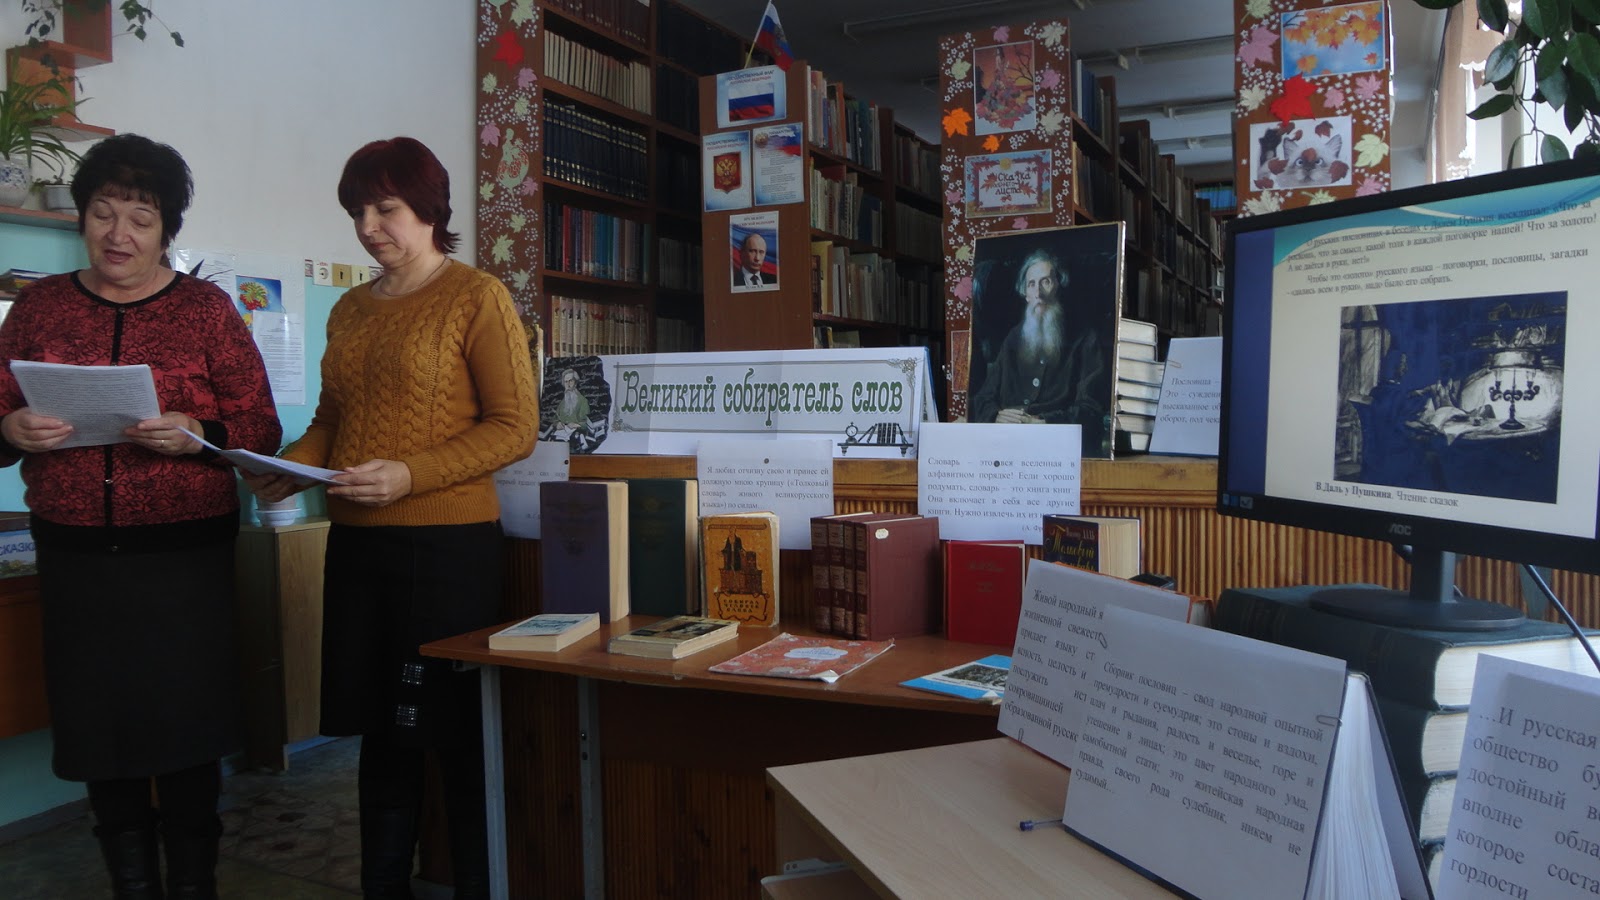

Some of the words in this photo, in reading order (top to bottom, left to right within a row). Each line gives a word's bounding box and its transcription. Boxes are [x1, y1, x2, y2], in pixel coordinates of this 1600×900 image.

[1445, 229, 1488, 242] поговорке
[1491, 223, 1524, 236] нашей!
[1527, 222, 1545, 232] Что
[1547, 220, 1558, 228] за
[1560, 213, 1597, 226] золото!
[1375, 267, 1408, 279] русского
[1442, 259, 1489, 271] поговорки,
[1491, 252, 1546, 266] пословицы,
[1549, 247, 1588, 260] загадки
[1384, 279, 1404, 289] было
[1406, 278, 1419, 287] его
[1420, 274, 1453, 287] собрать.
[621, 370, 719, 413] Великий
[724, 367, 844, 427] собиратель
[852, 380, 904, 413] слов
[1165, 389, 1179, 398] Это
[707, 466, 714, 474] Я
[820, 467, 829, 475] ей
[927, 457, 961, 468] Словарь
[927, 471, 975, 480] алфавитном
[979, 472, 1014, 482] порядке!
[1042, 474, 1075, 483] хорошо
[927, 484, 967, 493] подумать,
[968, 485, 1000, 494] словарь
[1026, 486, 1050, 494] книга
[927, 495, 943, 503] Она
[1002, 496, 1021, 505] себя
[1046, 500, 1074, 509] другие
[1345, 486, 1350, 496] у
[1351, 485, 1394, 500] Пушкина.
[1396, 490, 1427, 504] Чтение
[1428, 496, 1459, 507] сказок
[954, 509, 982, 517] Нужно
[1388, 523, 1412, 536] AOC
[1023, 610, 1062, 629] жизненной
[1032, 588, 1057, 606] Живой
[1058, 599, 1097, 620] народный
[1020, 628, 1047, 645] придает
[1054, 640, 1078, 658] языку
[1012, 665, 1049, 687] послужить
[1016, 645, 1044, 666] ясность,
[1047, 657, 1077, 677] целость
[1080, 670, 1087, 682] и
[1008, 684, 1064, 715] сокровищницей
[1103, 661, 1135, 681] Сборник
[1138, 675, 1177, 698] пословиц
[1193, 692, 1215, 709] свод
[1220, 700, 1268, 727] народной
[1274, 719, 1324, 745] опытной
[1004, 701, 1053, 731] образованной
[1093, 679, 1140, 705] премудрости
[1143, 697, 1149, 707] и
[1153, 700, 1202, 727] суемудрия;
[1207, 718, 1223, 732] это
[1227, 725, 1258, 747] стоны
[1263, 737, 1271, 749] и
[1277, 742, 1318, 770] вздохи,
[1089, 699, 1106, 713] плач
[1111, 705, 1117, 715] и
[1123, 709, 1160, 734] рыдания,
[1166, 725, 1200, 750] радость
[1208, 740, 1215, 752] и
[1223, 745, 1262, 772] веселье,
[1272, 764, 1297, 785] горе
[1306, 776, 1314, 789] и
[1521, 716, 1598, 750] русская
[1086, 715, 1121, 738] утешение
[1127, 730, 1132, 741] в
[1137, 734, 1166, 758] лицах;
[1173, 748, 1187, 764] это
[1194, 757, 1215, 775] цвет
[1224, 768, 1276, 799] народного
[1286, 792, 1309, 813] ума,
[1472, 735, 1560, 773] общество
[1082, 732, 1127, 761] самобытной
[1135, 754, 1161, 776] стати;
[1169, 768, 1184, 783] это
[1194, 779, 1244, 808] житейская
[1255, 804, 1305, 834] народная
[1466, 766, 1567, 811] достойный
[1078, 750, 1105, 772] правда,
[1114, 766, 1141, 787] своего
[1150, 781, 1170, 801] рода
[1181, 795, 1228, 827] судебник,
[1240, 820, 1273, 846] никем
[1287, 841, 1302, 857] не
[1461, 797, 1523, 830] вполне
[1455, 827, 1526, 865] которое
[1450, 857, 1530, 900] гордости
